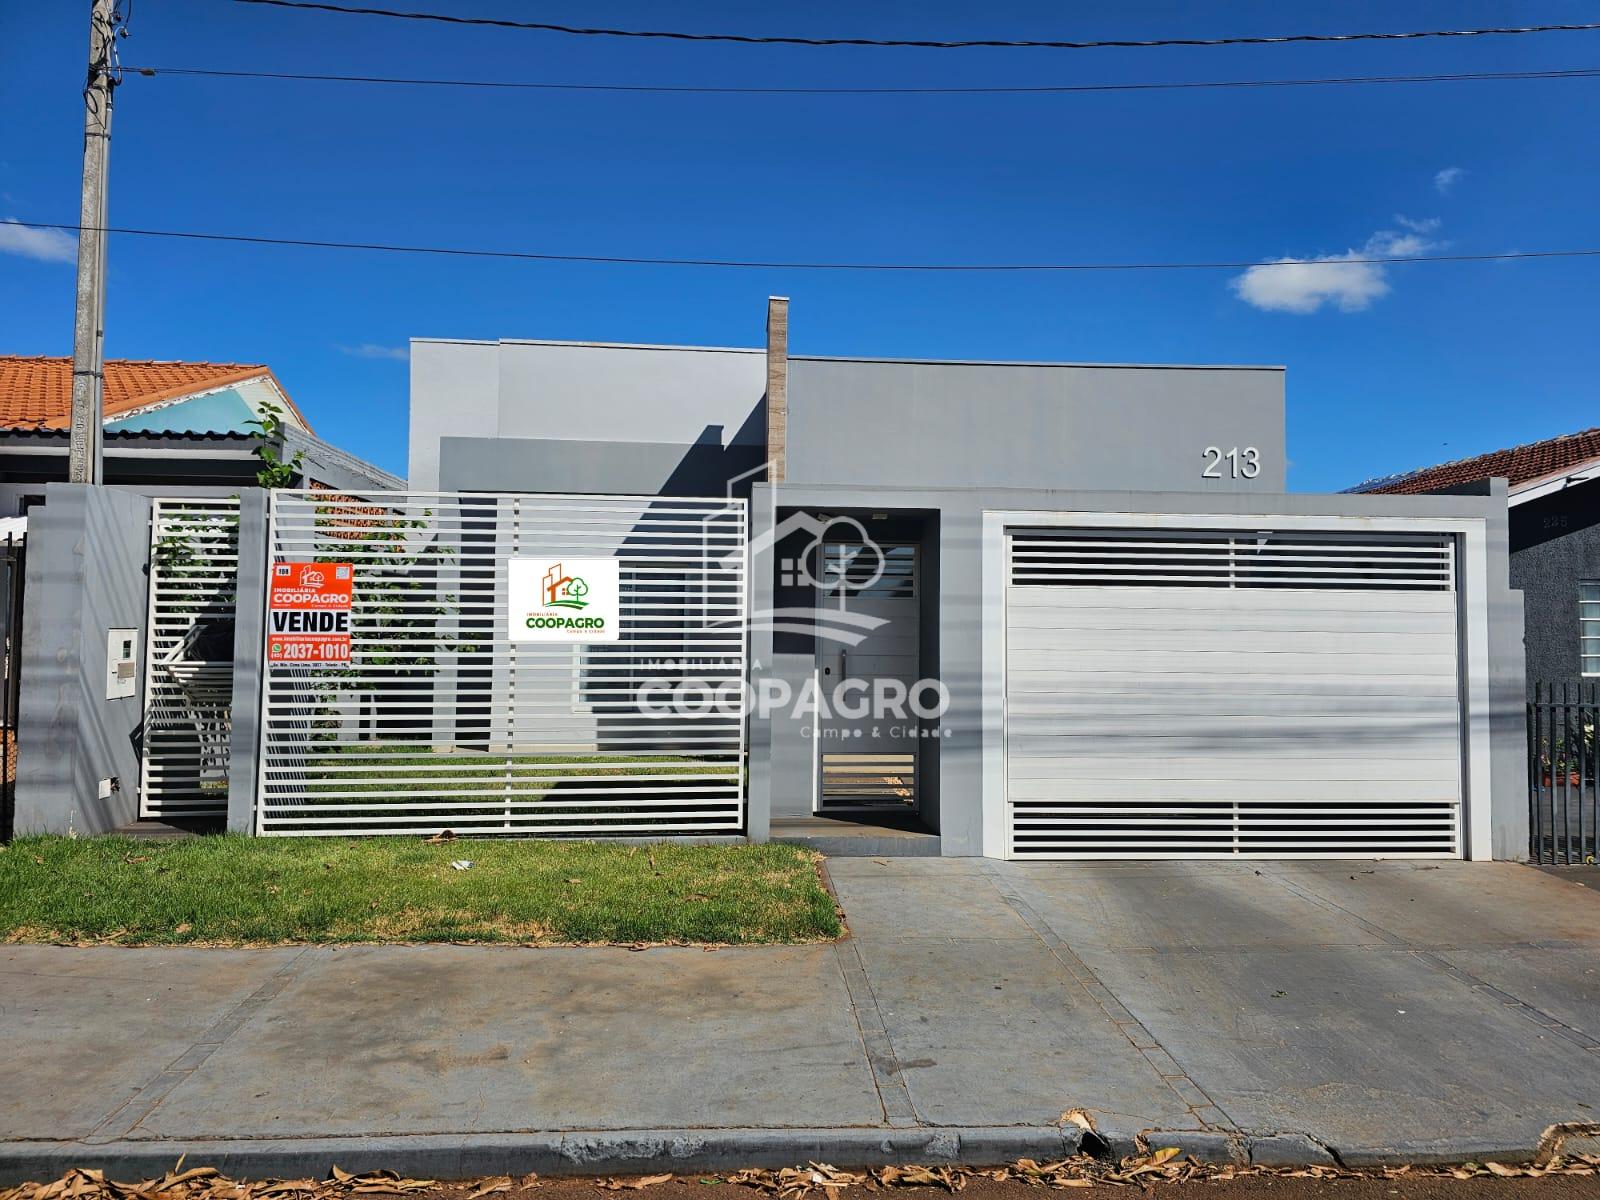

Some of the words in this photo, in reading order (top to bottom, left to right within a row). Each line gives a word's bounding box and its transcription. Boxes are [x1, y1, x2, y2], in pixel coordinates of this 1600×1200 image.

[1201, 446, 1261, 479] 213
[273, 593, 349, 604] COOPAGRO
[273, 611, 349, 632] VENDE
[283, 643, 349, 659] 2037-1010
